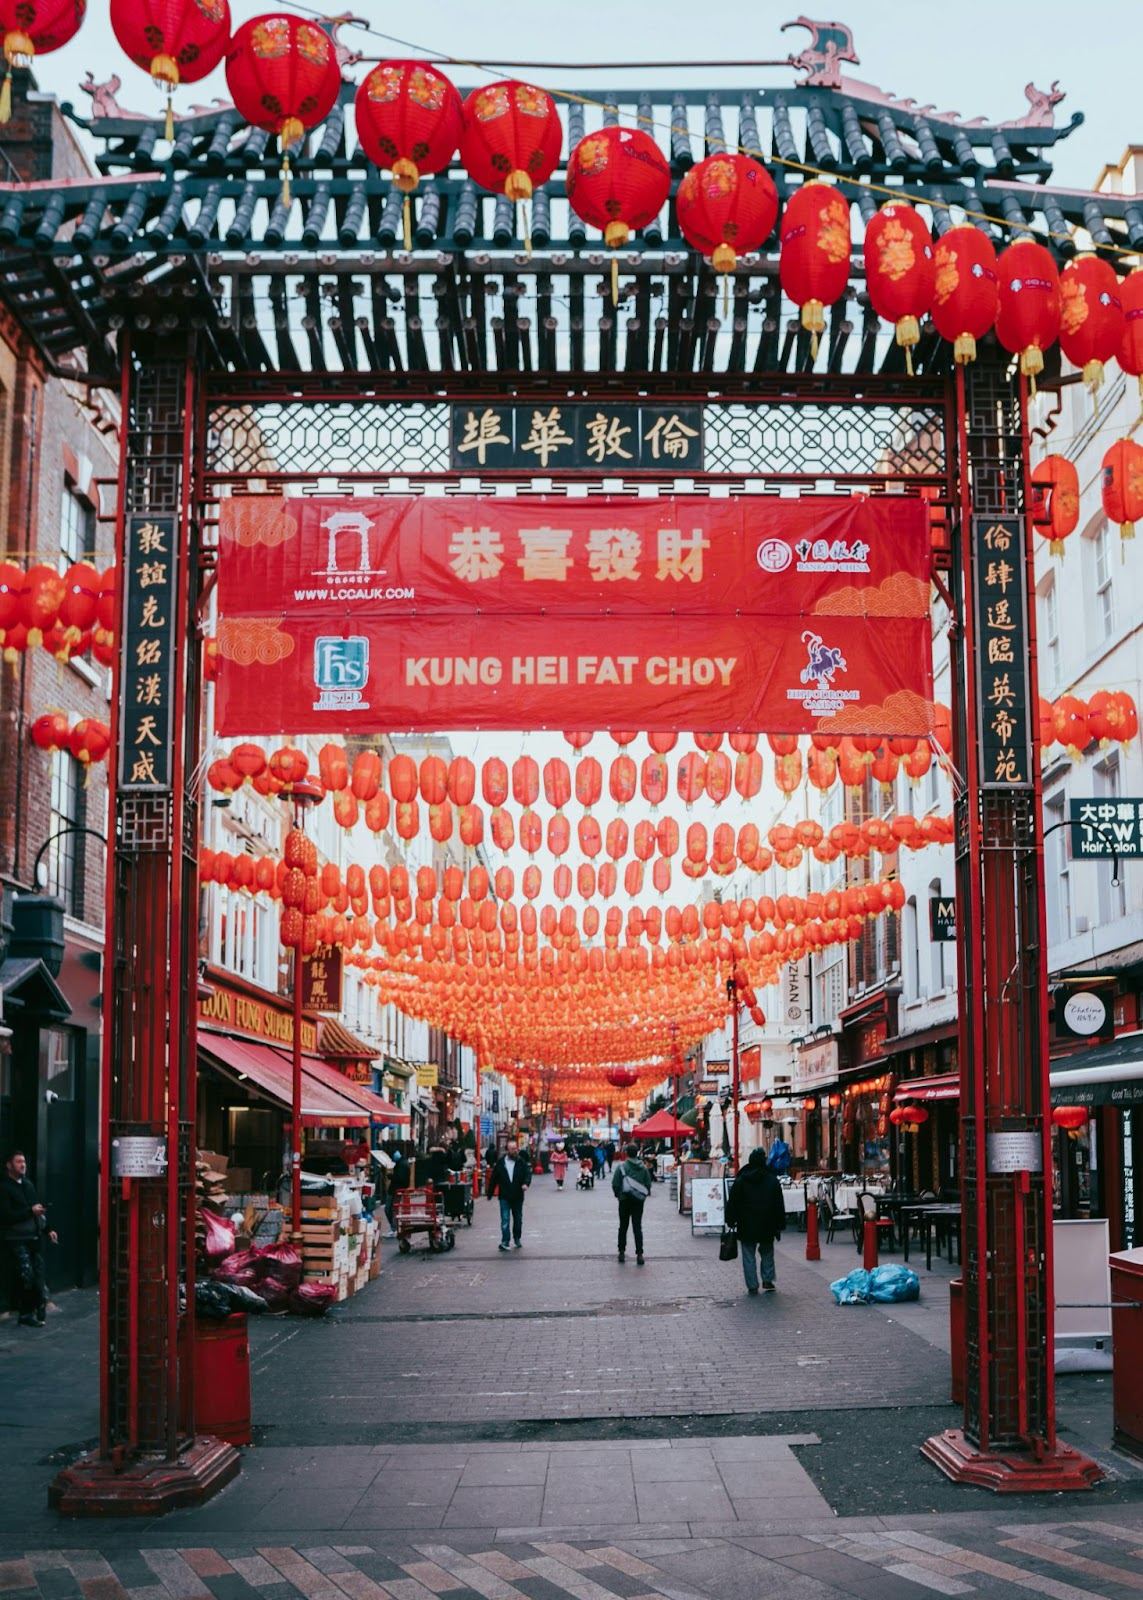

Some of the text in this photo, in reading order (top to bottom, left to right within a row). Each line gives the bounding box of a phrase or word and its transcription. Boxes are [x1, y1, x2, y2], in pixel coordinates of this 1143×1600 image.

[448, 527, 711, 583] 恭喜發財
[294, 588, 415, 601] WWW.LCCAUK.COM
[405, 656, 737, 686] KUNG HEI FAT CHOY
[1080, 822, 1135, 842] TCW
[1081, 840, 1137, 853] Hair Salon
[235, 998, 261, 1033] FUNG
